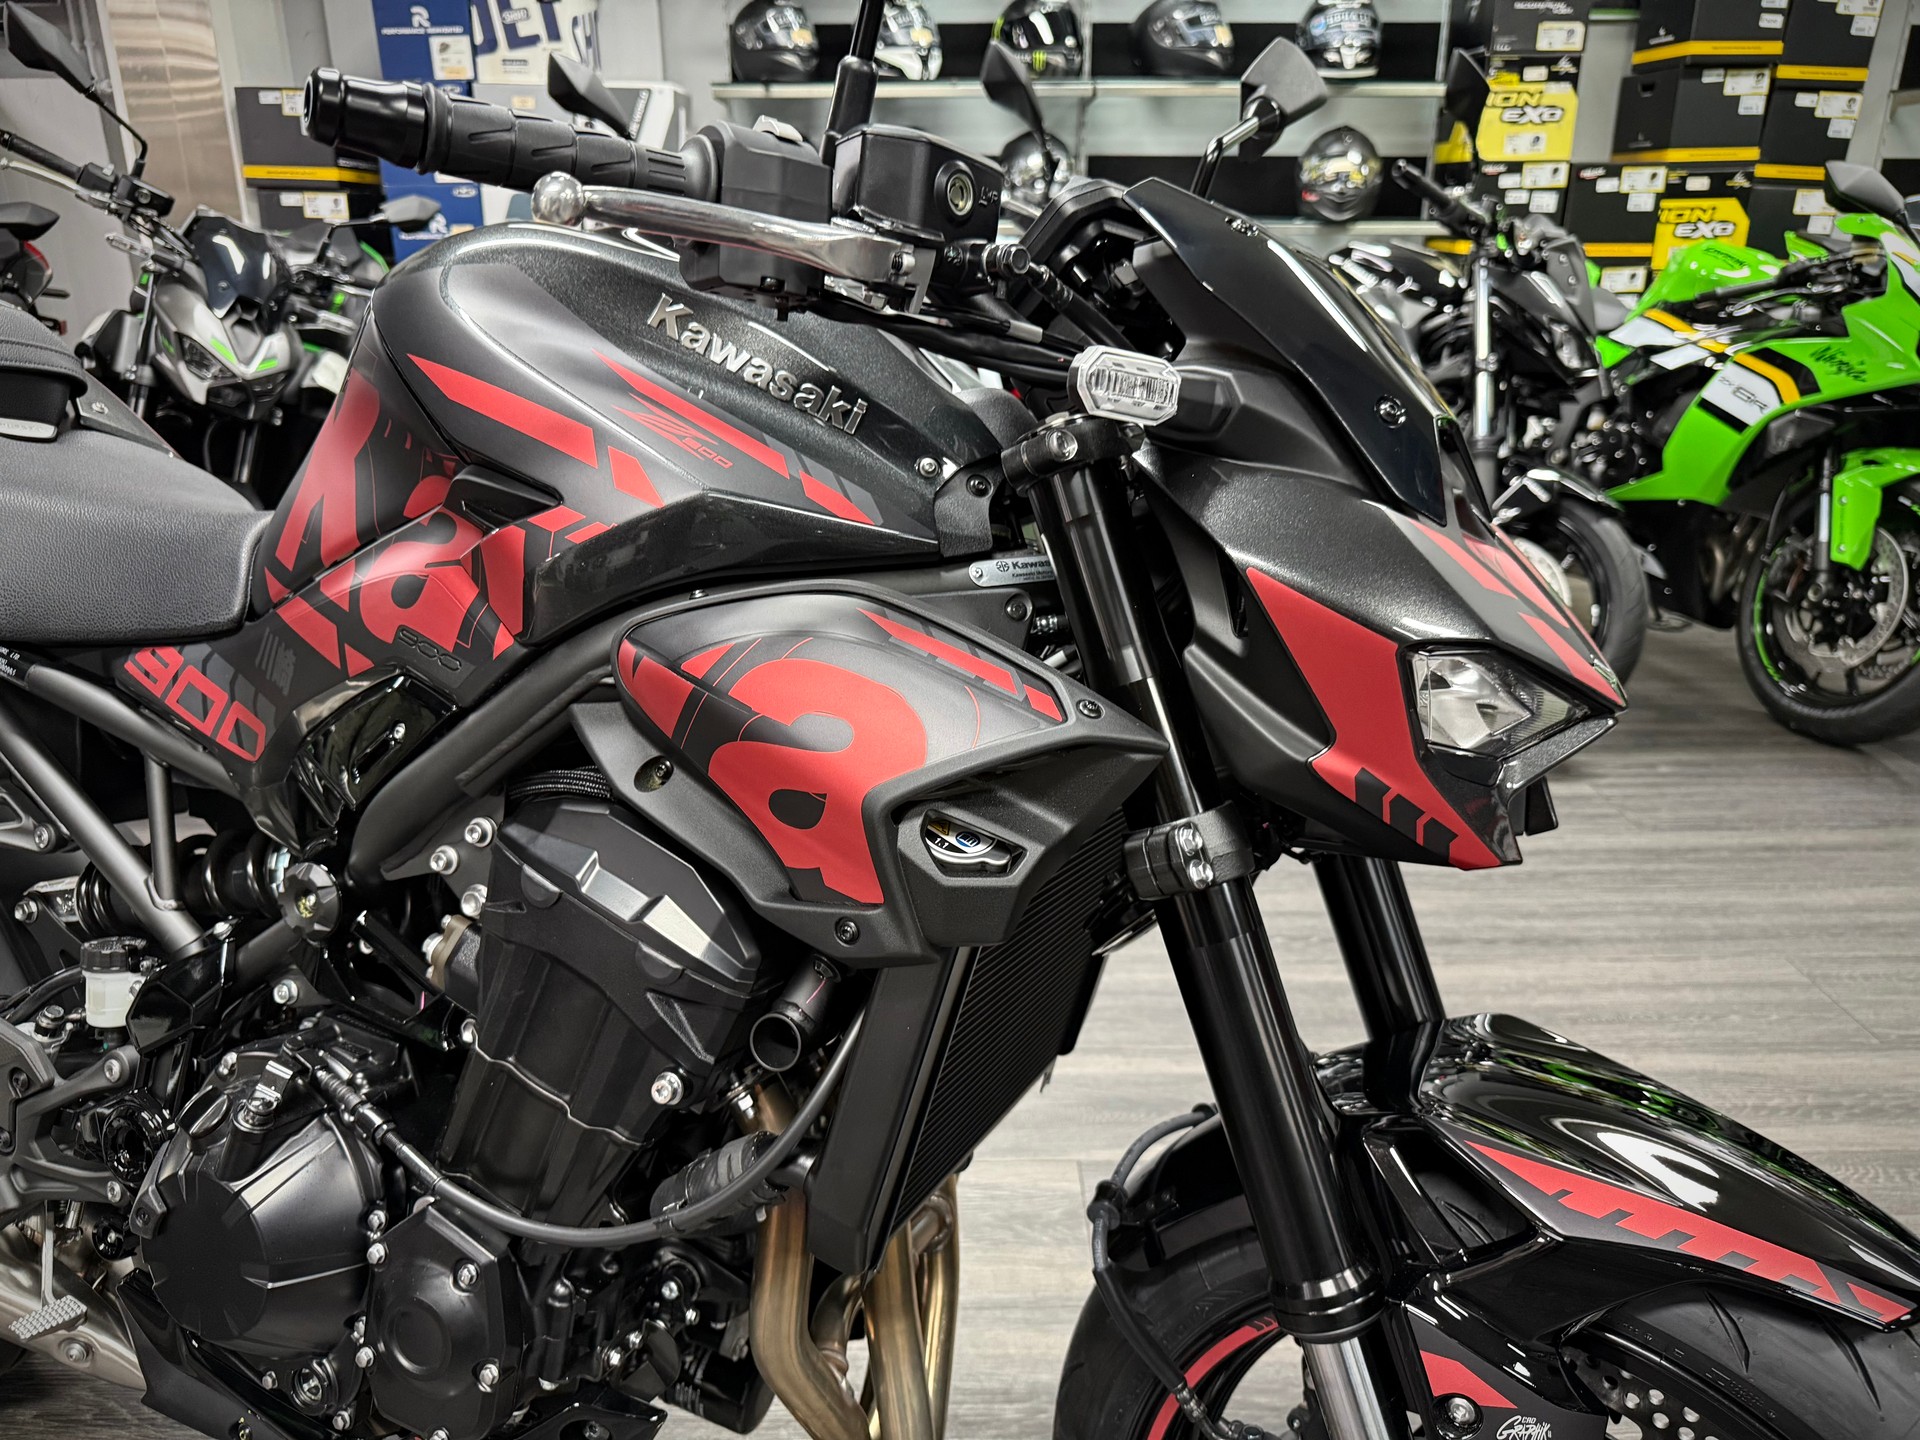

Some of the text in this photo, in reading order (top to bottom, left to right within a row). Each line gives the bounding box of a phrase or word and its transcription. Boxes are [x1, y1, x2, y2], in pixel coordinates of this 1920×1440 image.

[1500, 106, 1564, 125] EXO
[1674, 220, 1736, 239] EXO
[646, 292, 869, 436] Kawasaki
[124, 646, 266, 761] 900
[934, 837, 950, 849] 1.1
